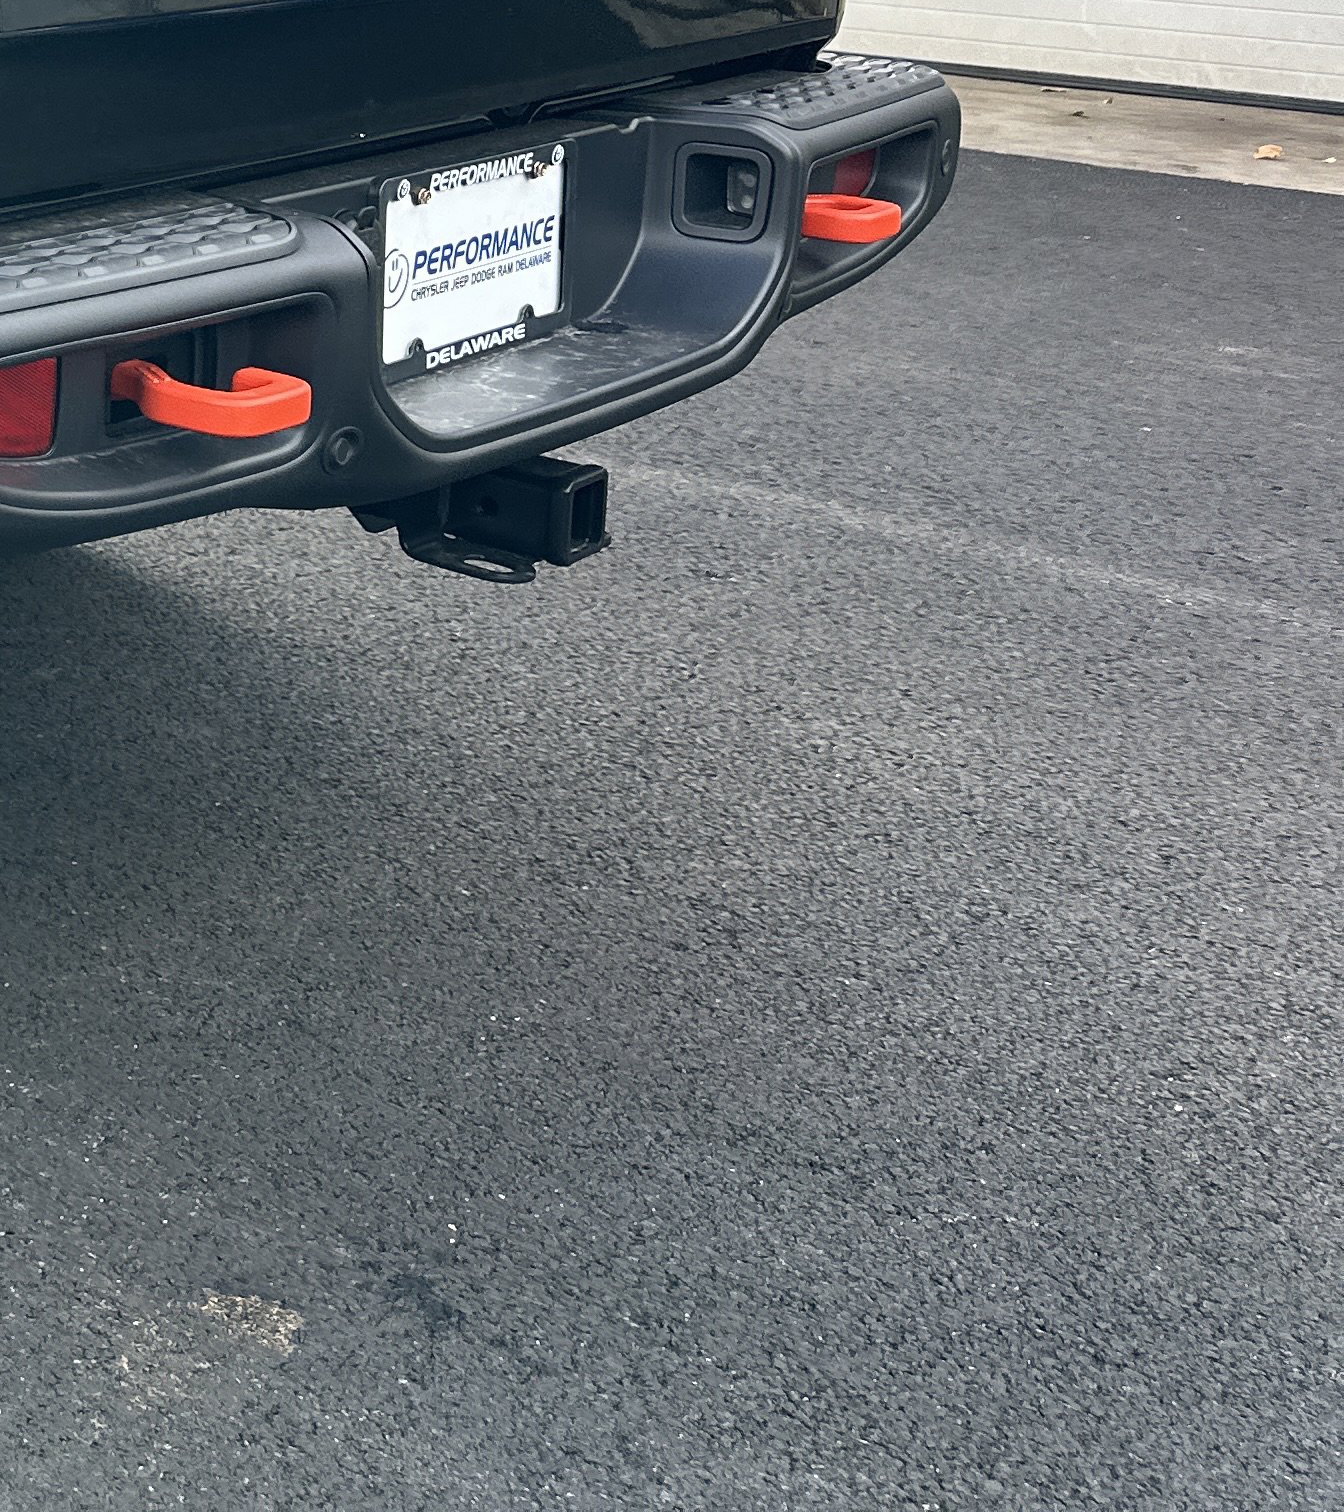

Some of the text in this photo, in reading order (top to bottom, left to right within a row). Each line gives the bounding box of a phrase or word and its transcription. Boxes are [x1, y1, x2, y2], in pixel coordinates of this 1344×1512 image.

[430, 152, 533, 189] PERFORMANCE
[412, 215, 555, 280] PERFORMANCE
[411, 251, 551, 301] CHRYSLER JEEP DODGE RAM DELAWARE
[426, 323, 526, 369] DELAWARE
